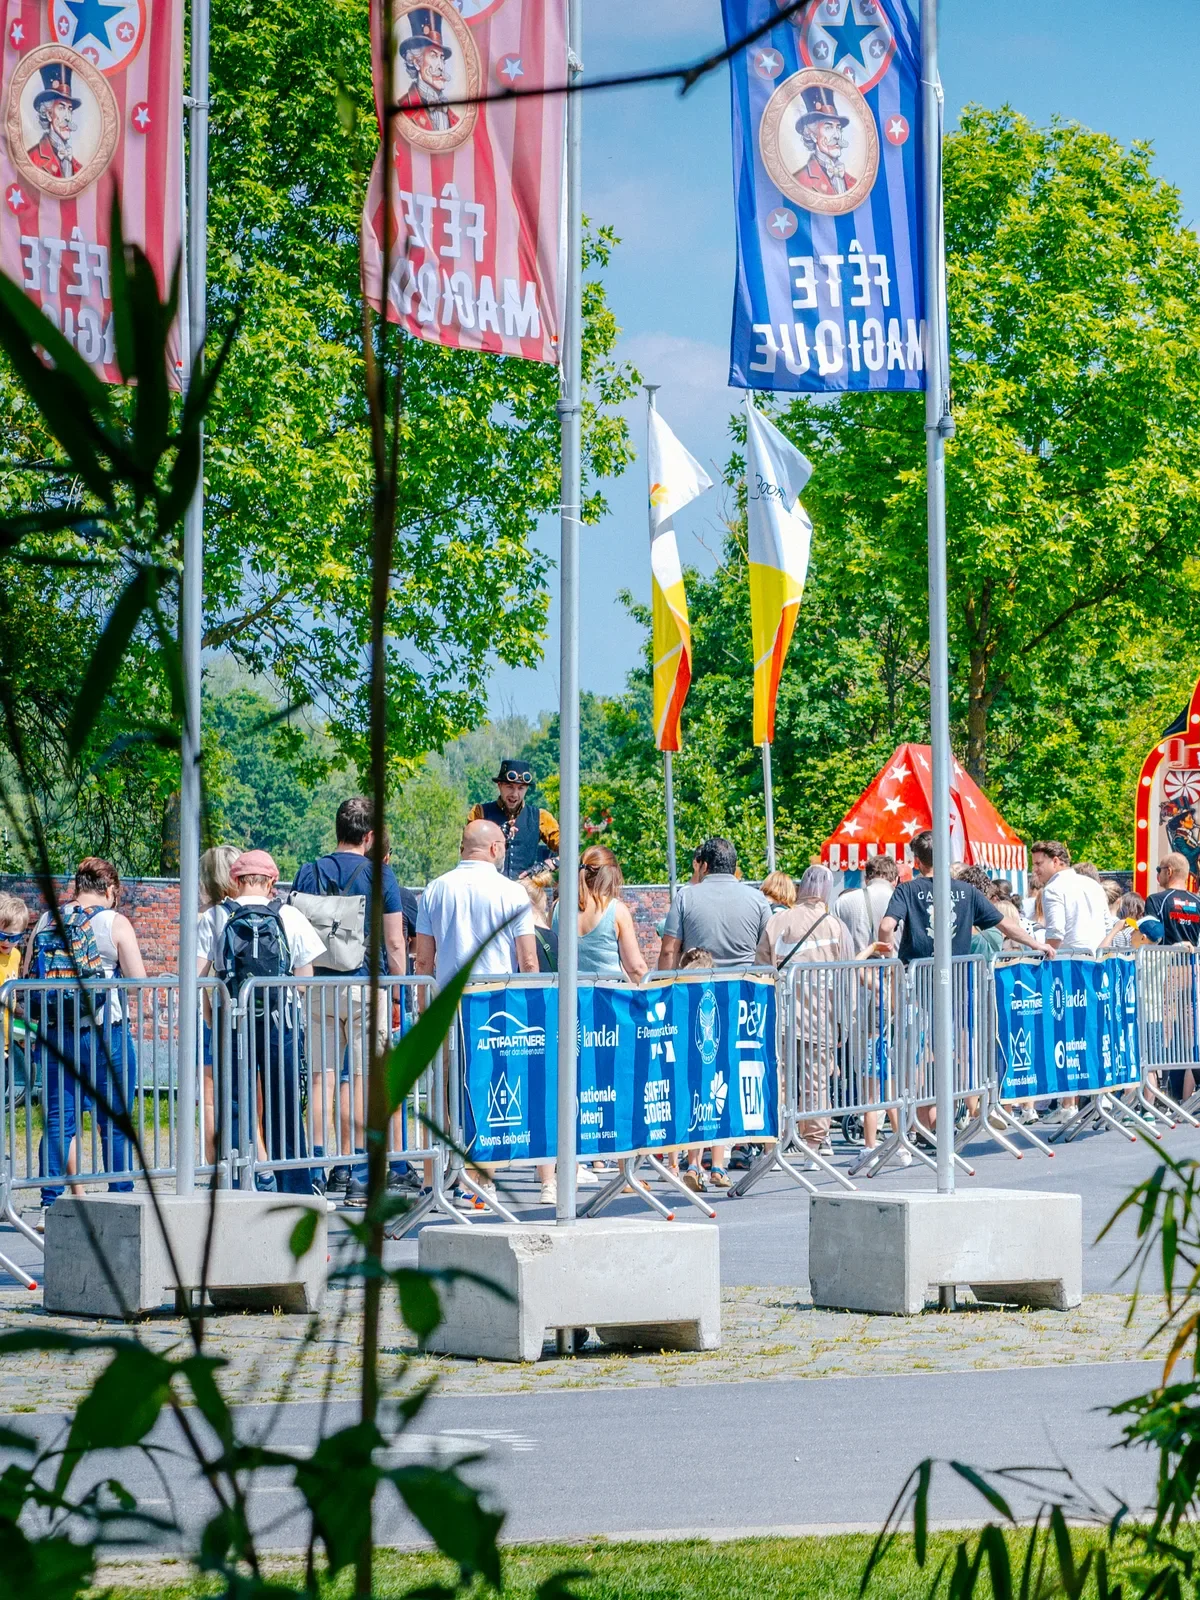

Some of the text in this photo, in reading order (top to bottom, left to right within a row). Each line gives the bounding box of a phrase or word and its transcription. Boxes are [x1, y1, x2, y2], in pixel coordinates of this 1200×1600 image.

[917, 890, 966, 900] GARIE
[583, 1024, 619, 1047] landal
[580, 1085, 616, 1103] nationale
[580, 1106, 603, 1128] loterij
[644, 1101, 672, 1125] JOGER
